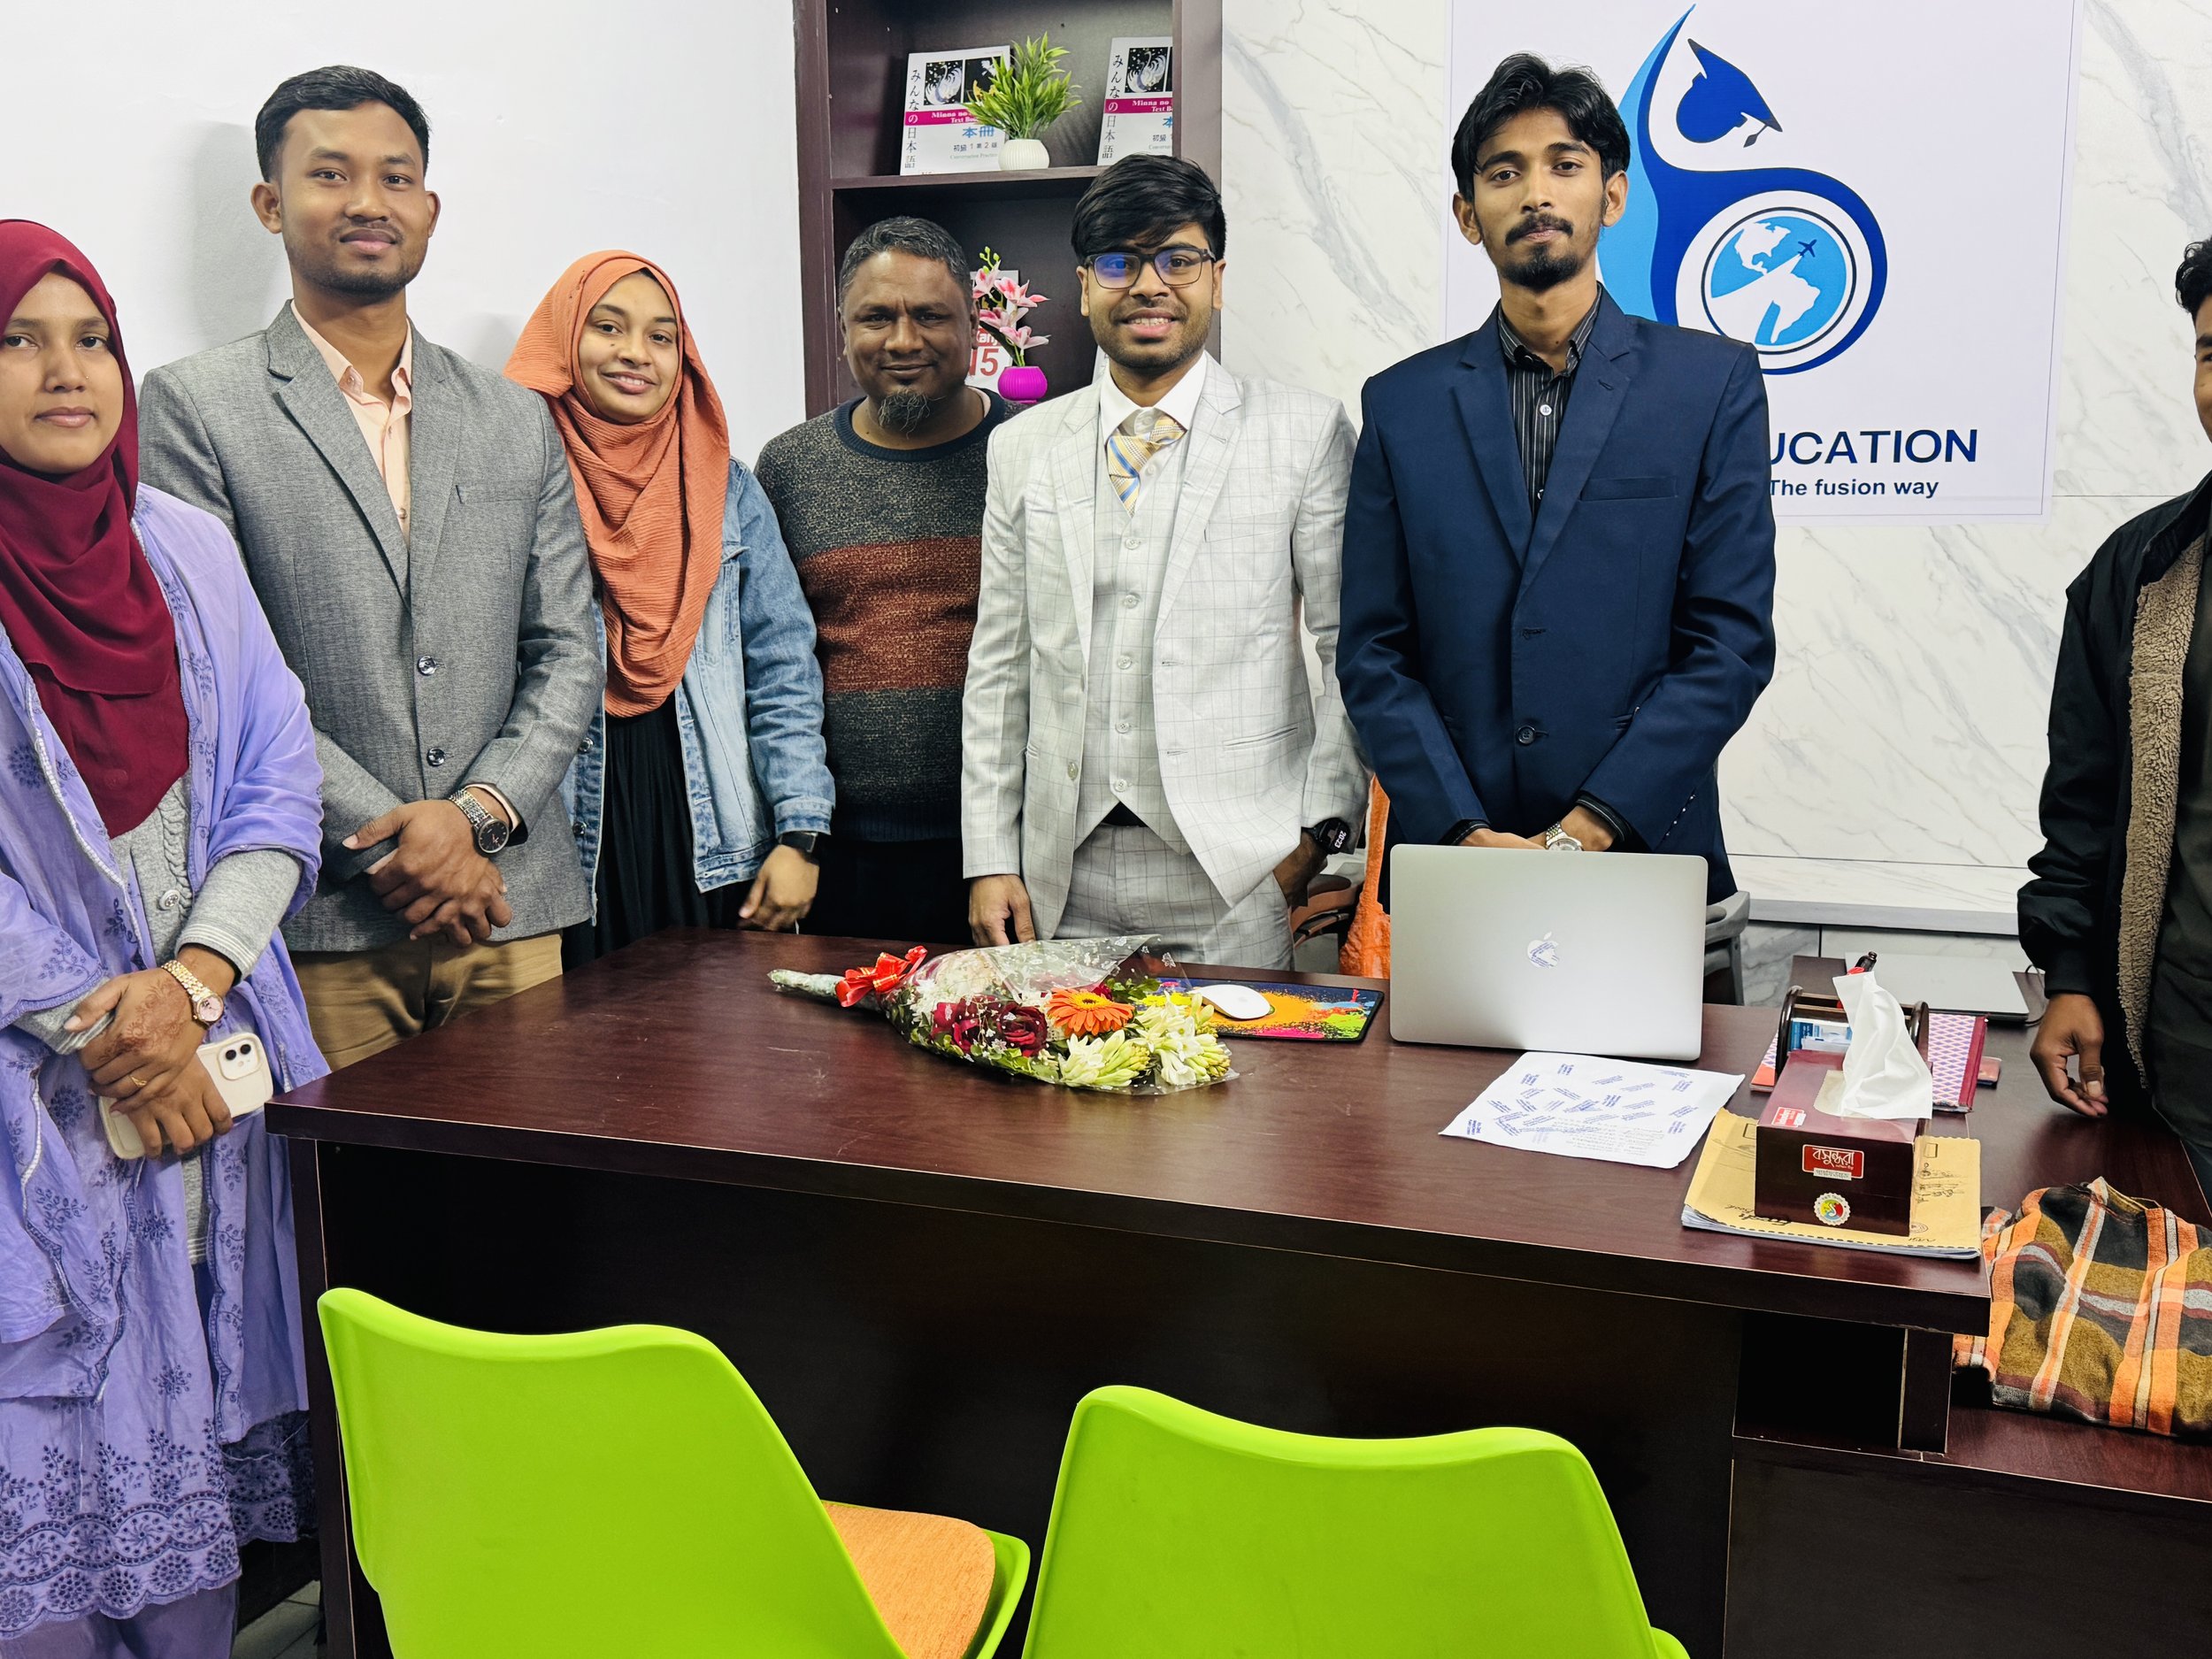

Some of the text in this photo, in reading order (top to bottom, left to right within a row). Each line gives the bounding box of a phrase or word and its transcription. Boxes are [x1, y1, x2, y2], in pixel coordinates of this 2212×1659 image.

[904, 70, 921, 168] みんなの日本語
[1102, 55, 1124, 158] みんなの日本語
[1770, 479, 1939, 498] The fusion way
[1812, 1148, 1855, 1168] বসুন্ধরা
